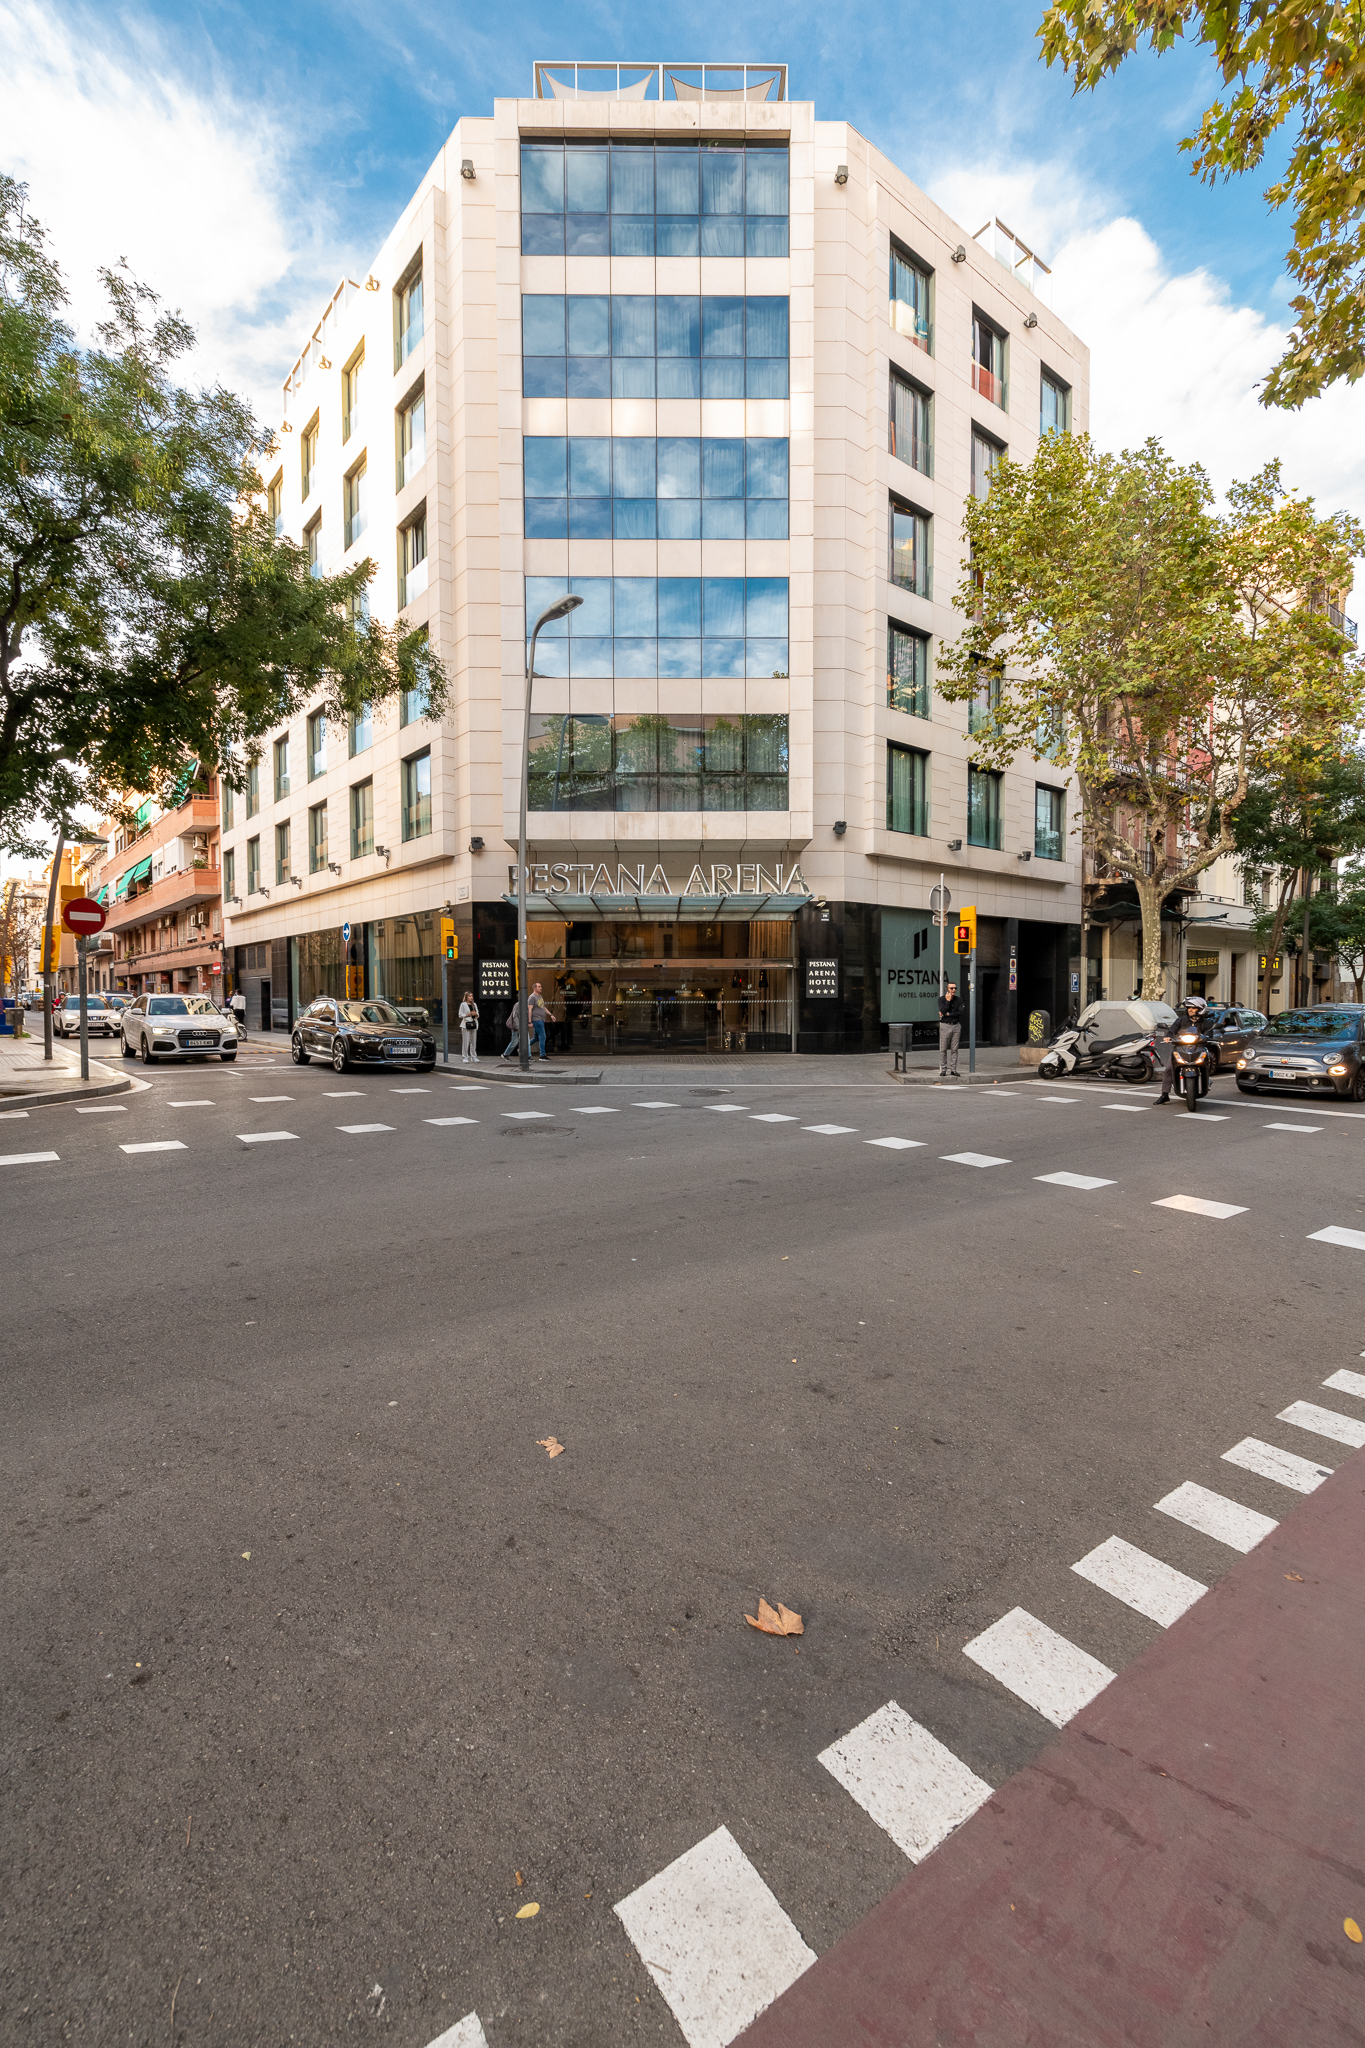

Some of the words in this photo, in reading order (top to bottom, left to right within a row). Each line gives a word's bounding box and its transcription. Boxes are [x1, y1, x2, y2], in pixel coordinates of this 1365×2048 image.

[508, 863, 672, 895] PESTANA
[683, 863, 811, 895] ARENA
[1186, 958, 1198, 967] FEEL
[1197, 957, 1208, 966] THE
[887, 969, 950, 985] PESTANA
[1072, 974, 1078, 986] P
